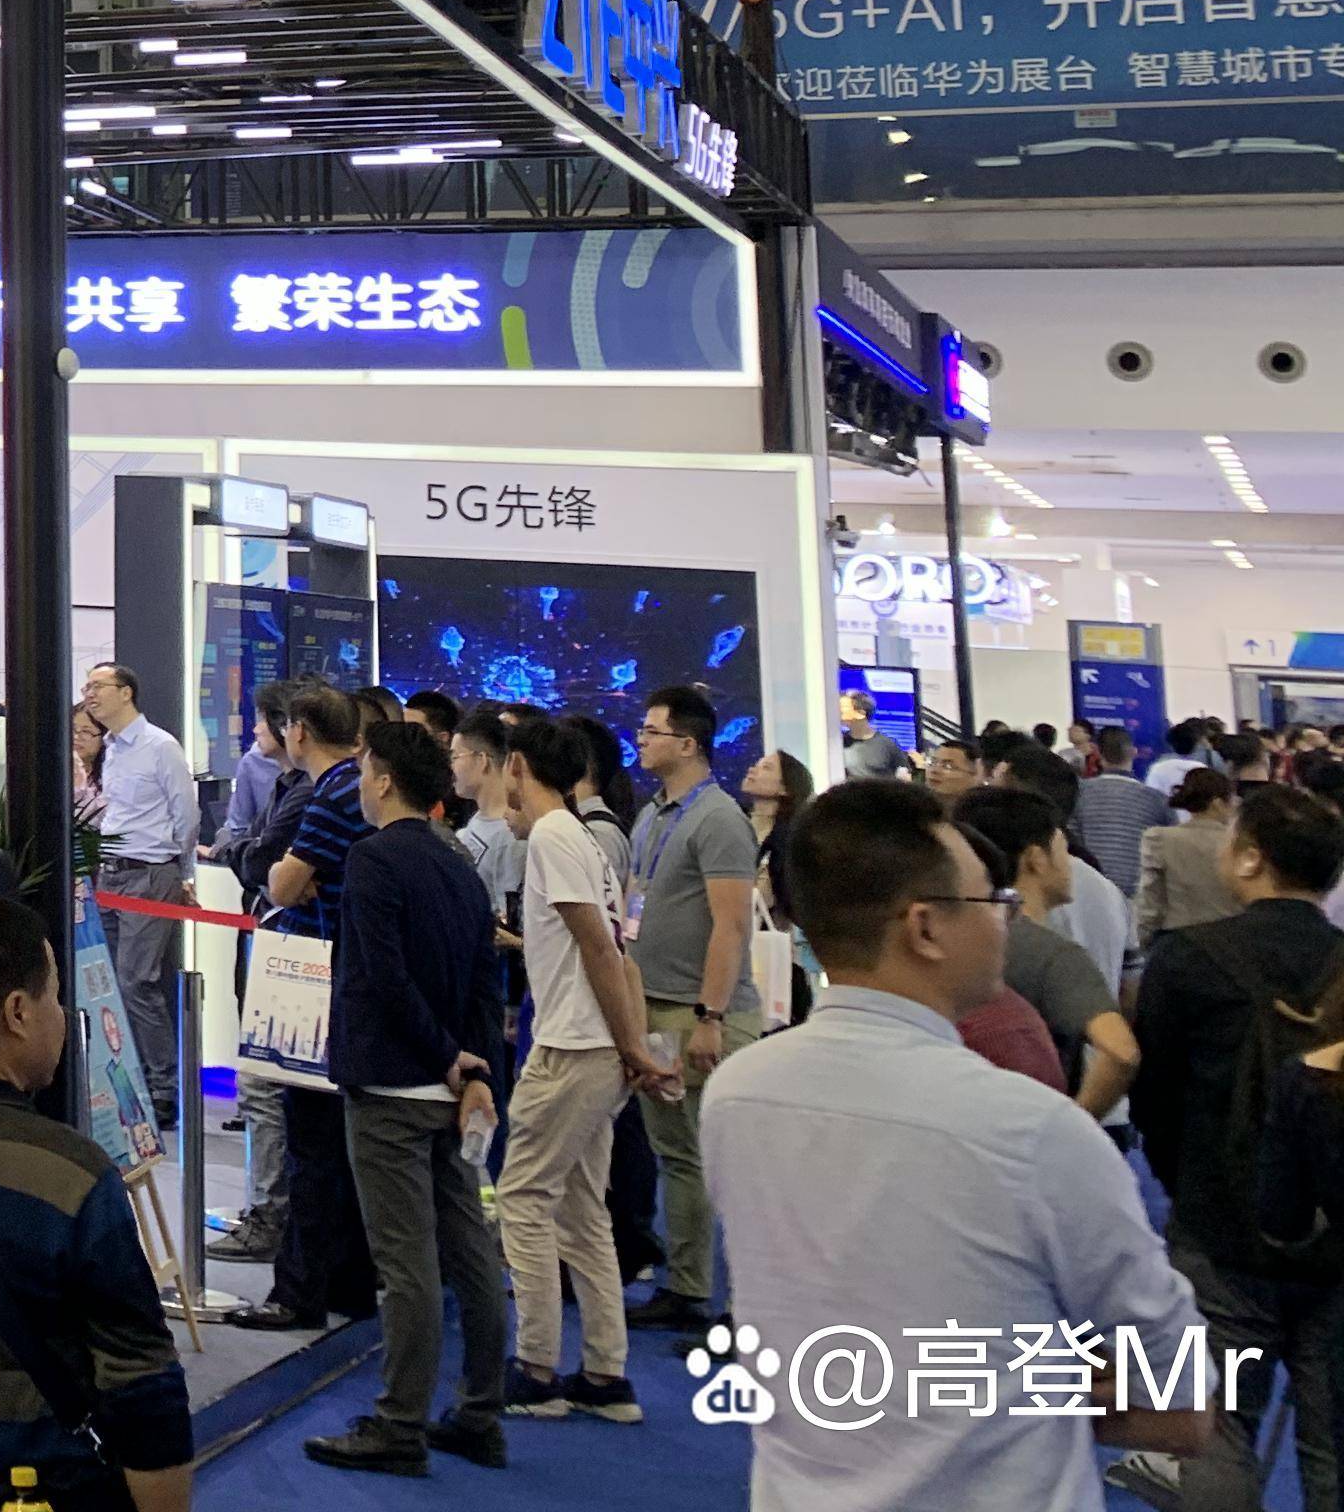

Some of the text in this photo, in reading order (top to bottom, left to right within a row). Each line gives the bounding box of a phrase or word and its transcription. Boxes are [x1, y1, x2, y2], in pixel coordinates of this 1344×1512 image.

[229, 272, 481, 333] 繁荣生态
[426, 483, 597, 532] 5G先锋
[266, 956, 301, 973] CITE
